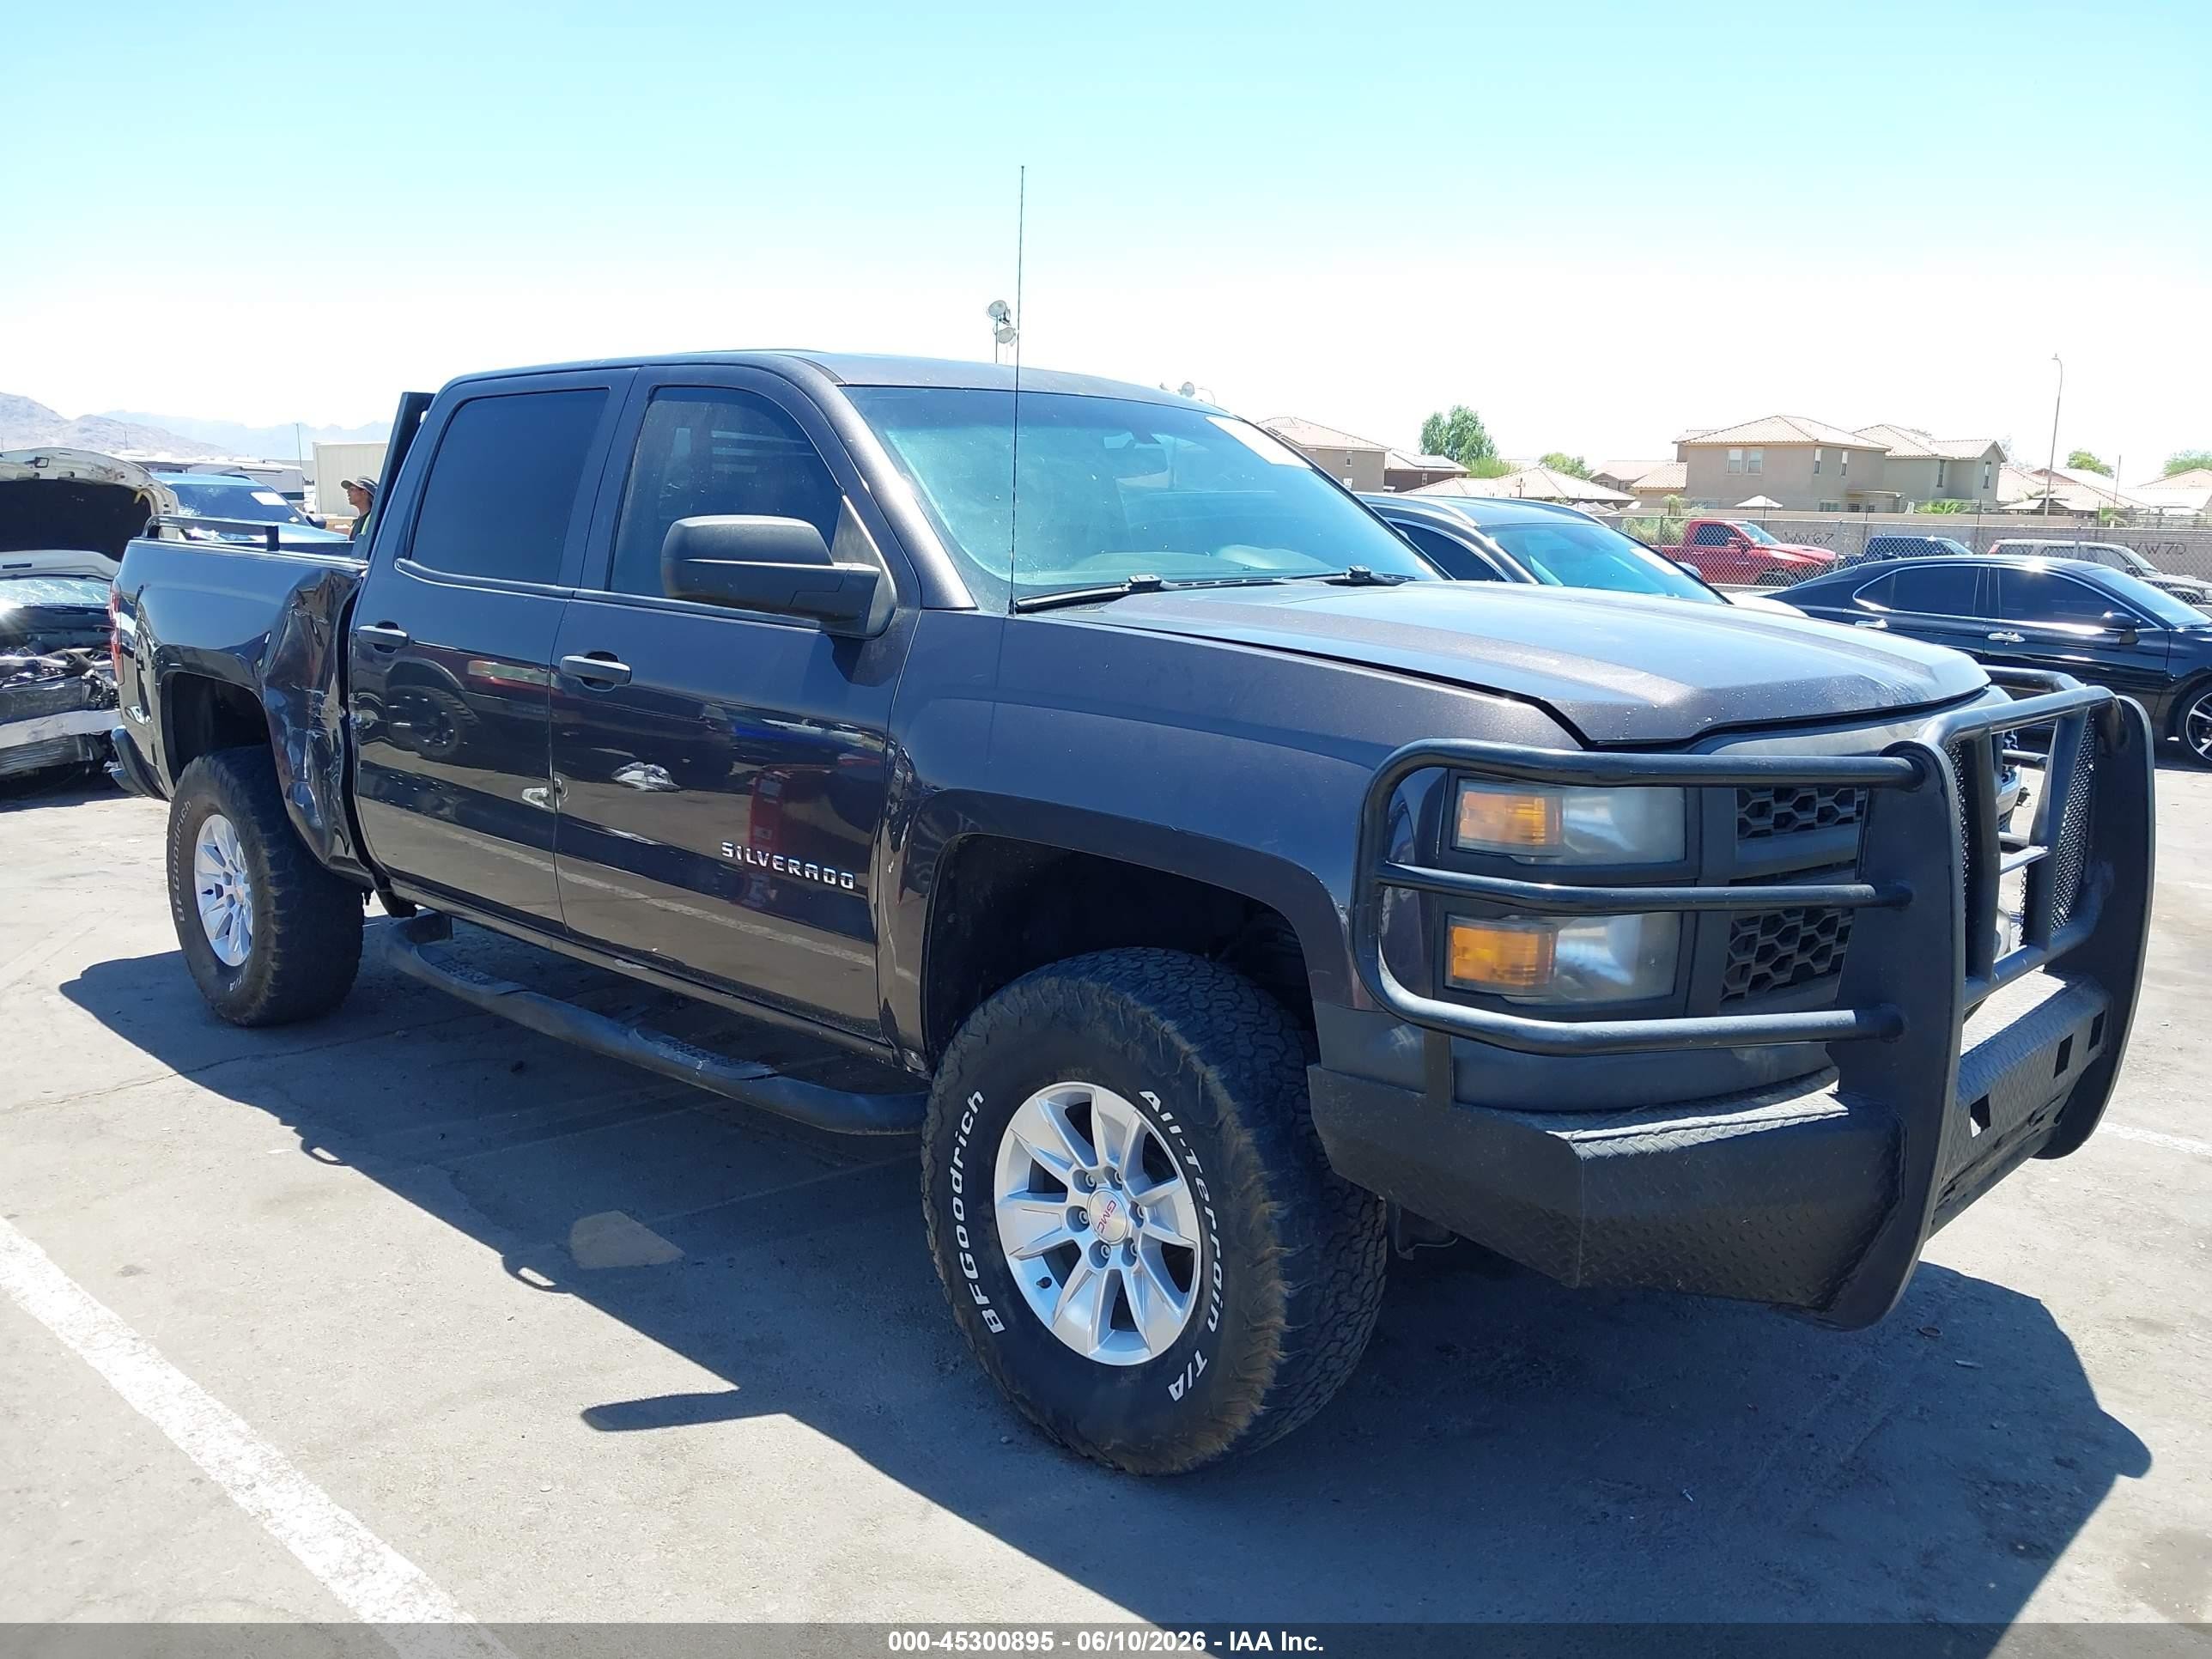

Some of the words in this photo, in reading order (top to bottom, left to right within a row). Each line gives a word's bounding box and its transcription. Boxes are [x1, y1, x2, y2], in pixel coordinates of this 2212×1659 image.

[1813, 532, 1834, 544] 67
[721, 842, 855, 890] SILVERADO
[949, 1090, 1006, 1334] BFGoodrich
[1097, 1199, 1117, 1235] GMC
[1139, 1090, 1224, 1334] All-Terrain
[1168, 1349, 1210, 1402] T/A
